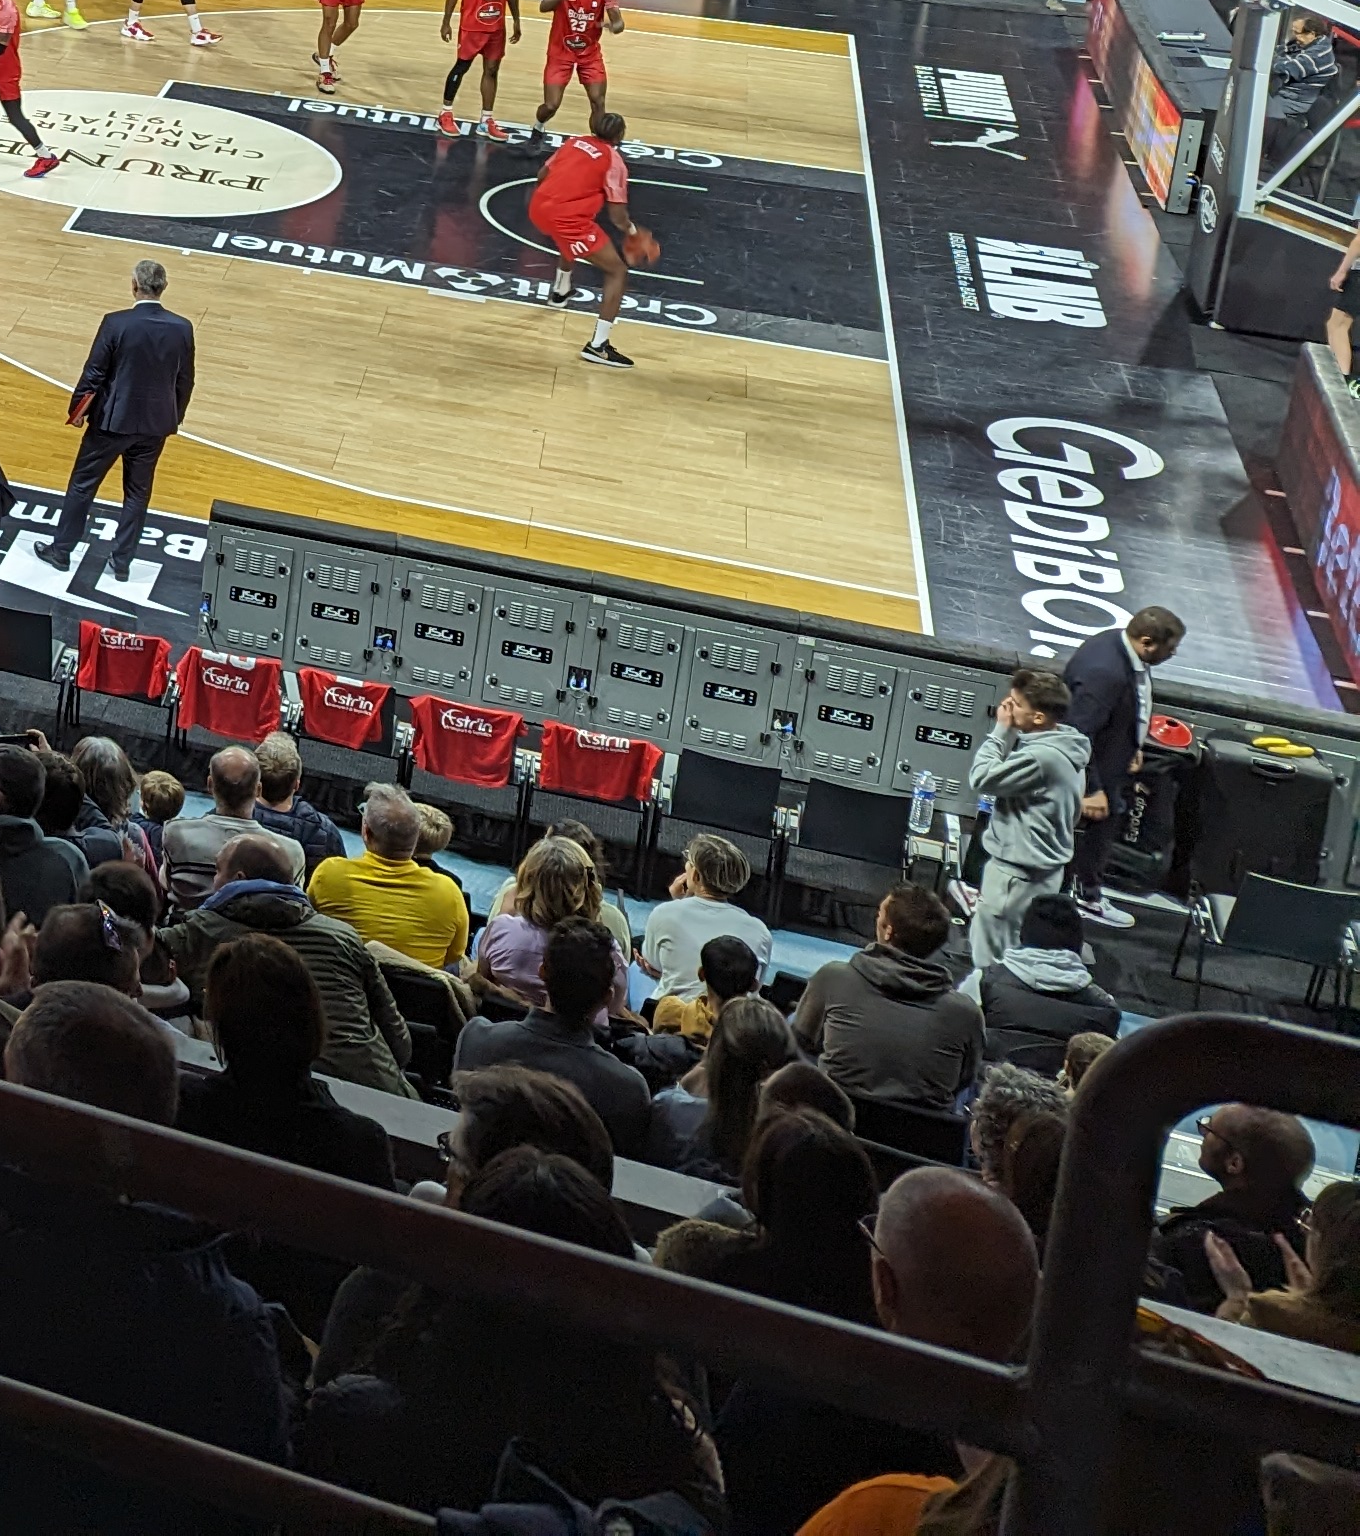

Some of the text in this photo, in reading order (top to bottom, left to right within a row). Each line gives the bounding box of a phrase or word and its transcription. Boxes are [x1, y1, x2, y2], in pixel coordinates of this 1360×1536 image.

[570, 19, 588, 32] 23
[914, 64, 943, 112] BASKETBALL
[938, 67, 1017, 122] PUMA
[107, 109, 183, 129] 1931
[212, 231, 427, 281] Mutuel
[977, 252, 1108, 328] LNB
[1125, 797, 1148, 843] EuroCup
